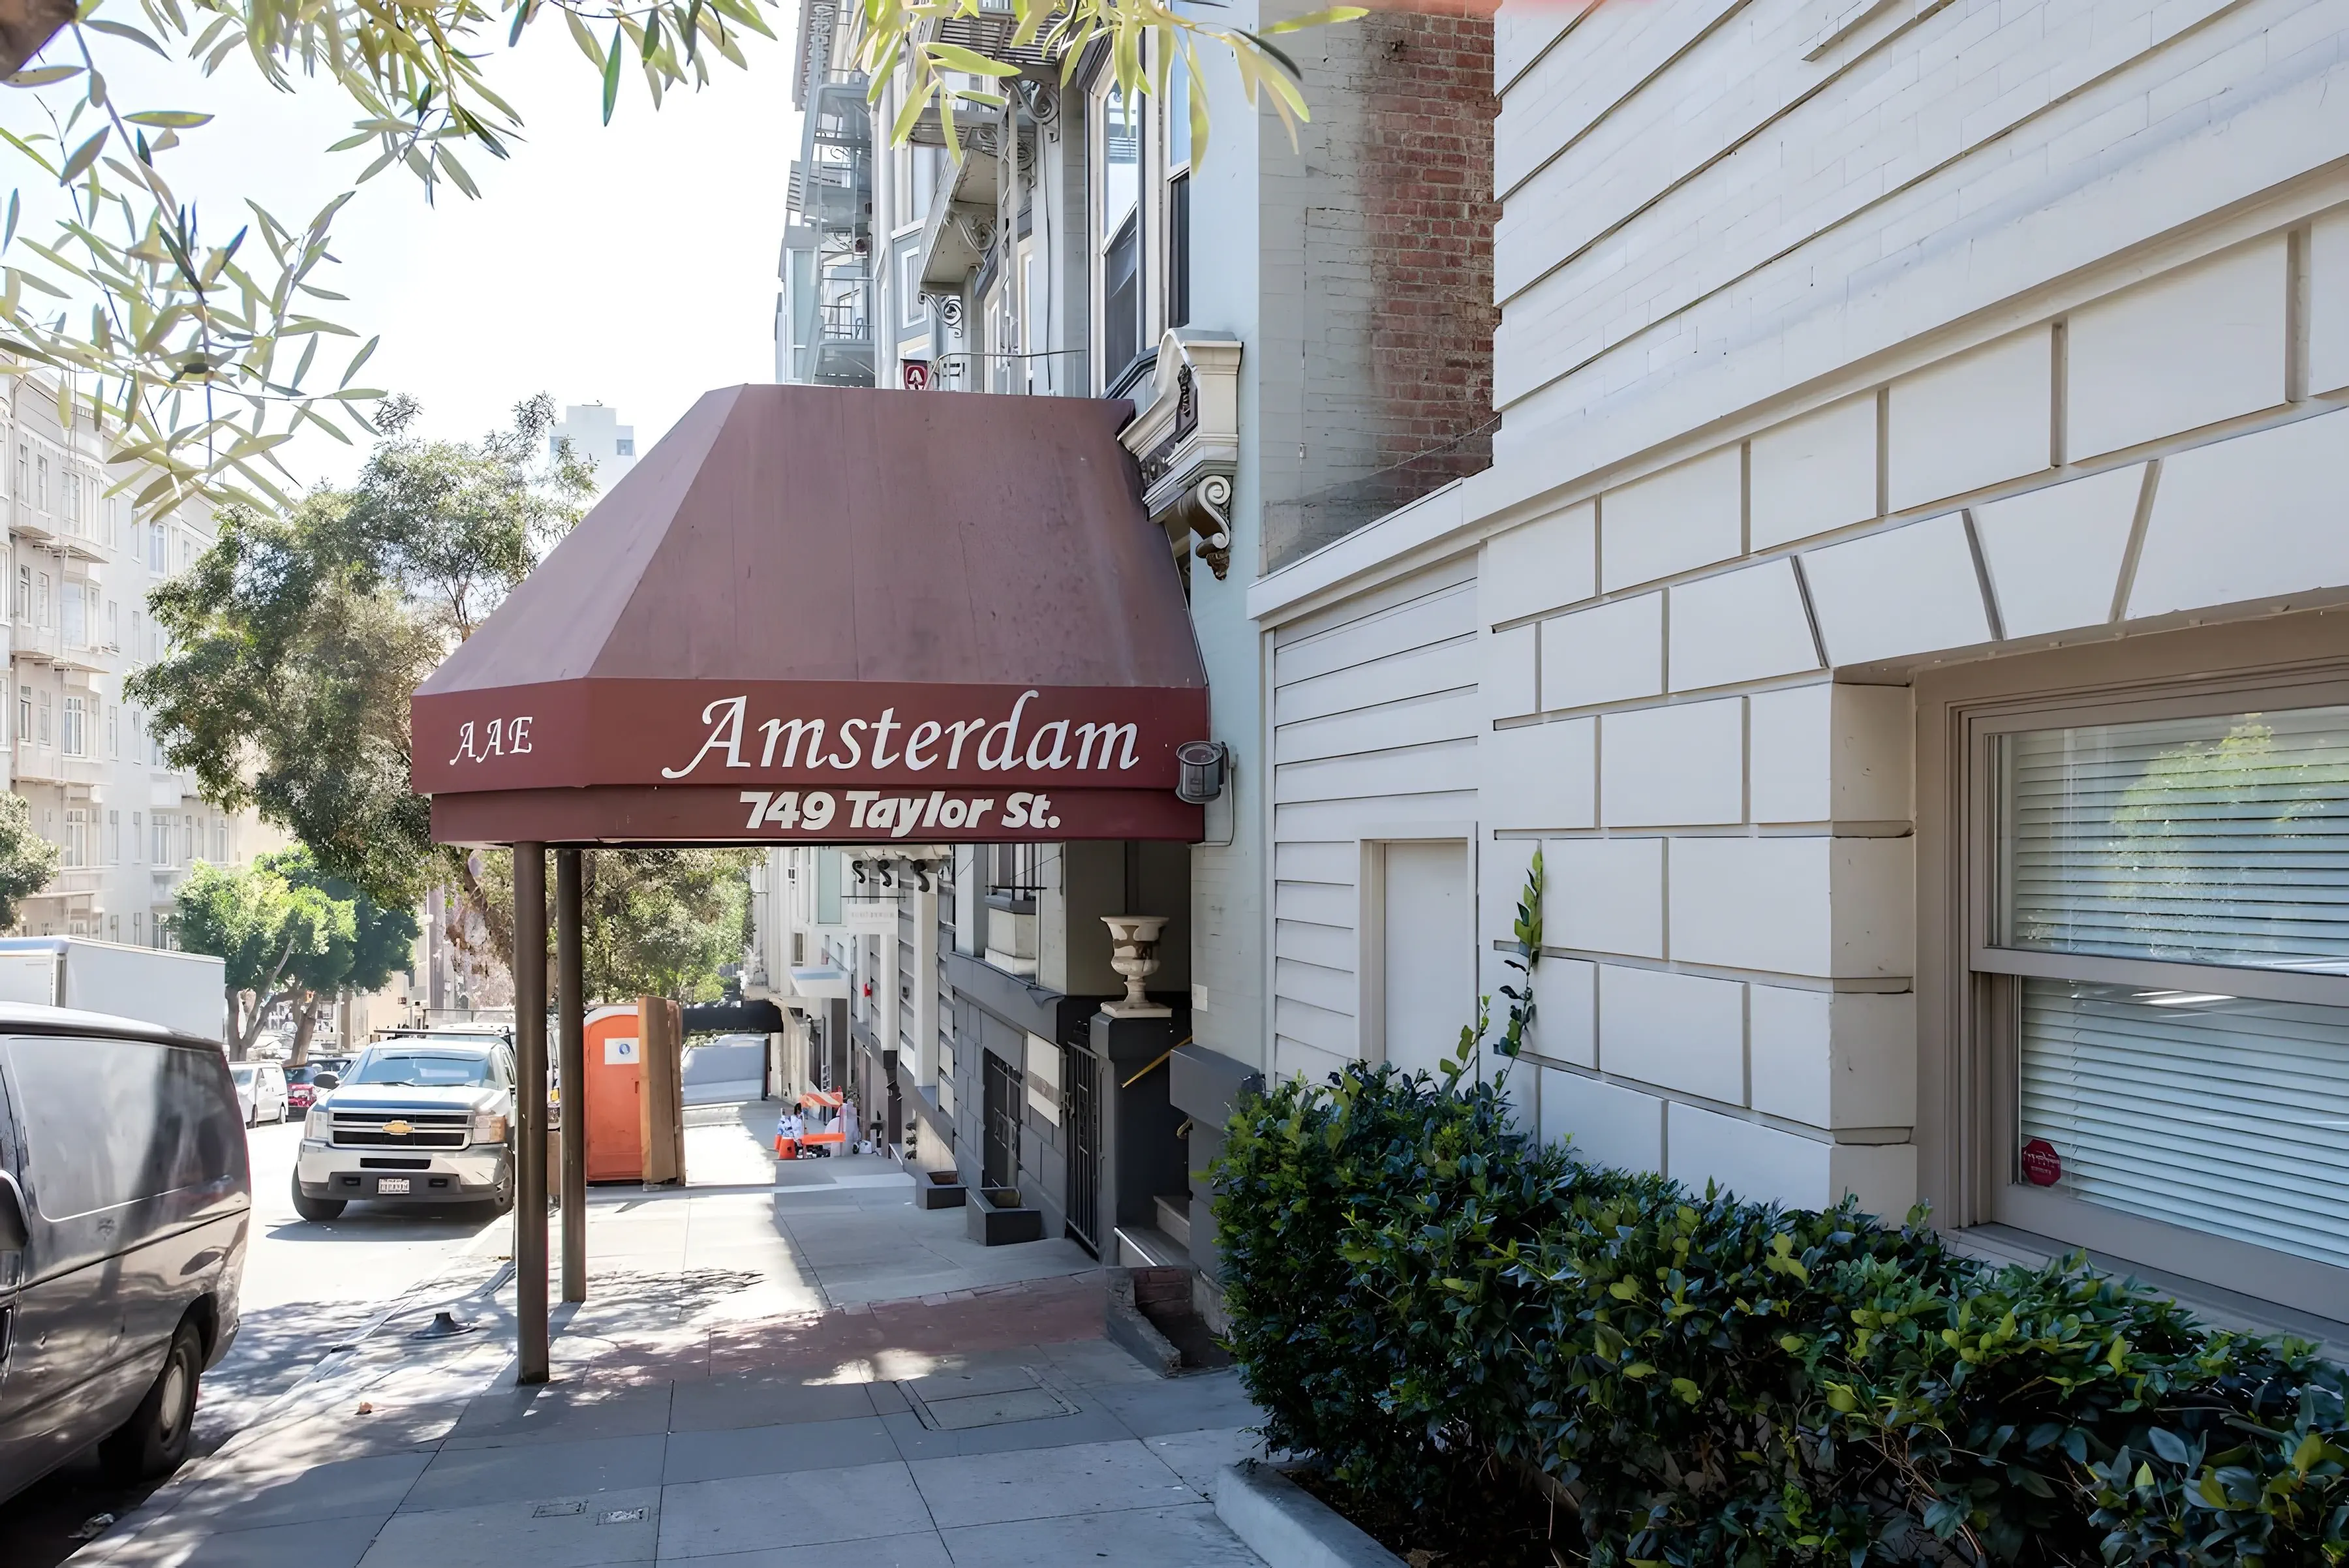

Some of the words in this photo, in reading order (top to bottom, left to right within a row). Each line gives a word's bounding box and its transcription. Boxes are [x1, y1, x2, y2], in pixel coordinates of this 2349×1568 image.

[449, 716, 533, 765] AAE
[661, 690, 1139, 778] Amsterdam
[739, 791, 836, 830] 749
[845, 791, 994, 838] Taylor
[1001, 792, 1061, 829] St.
